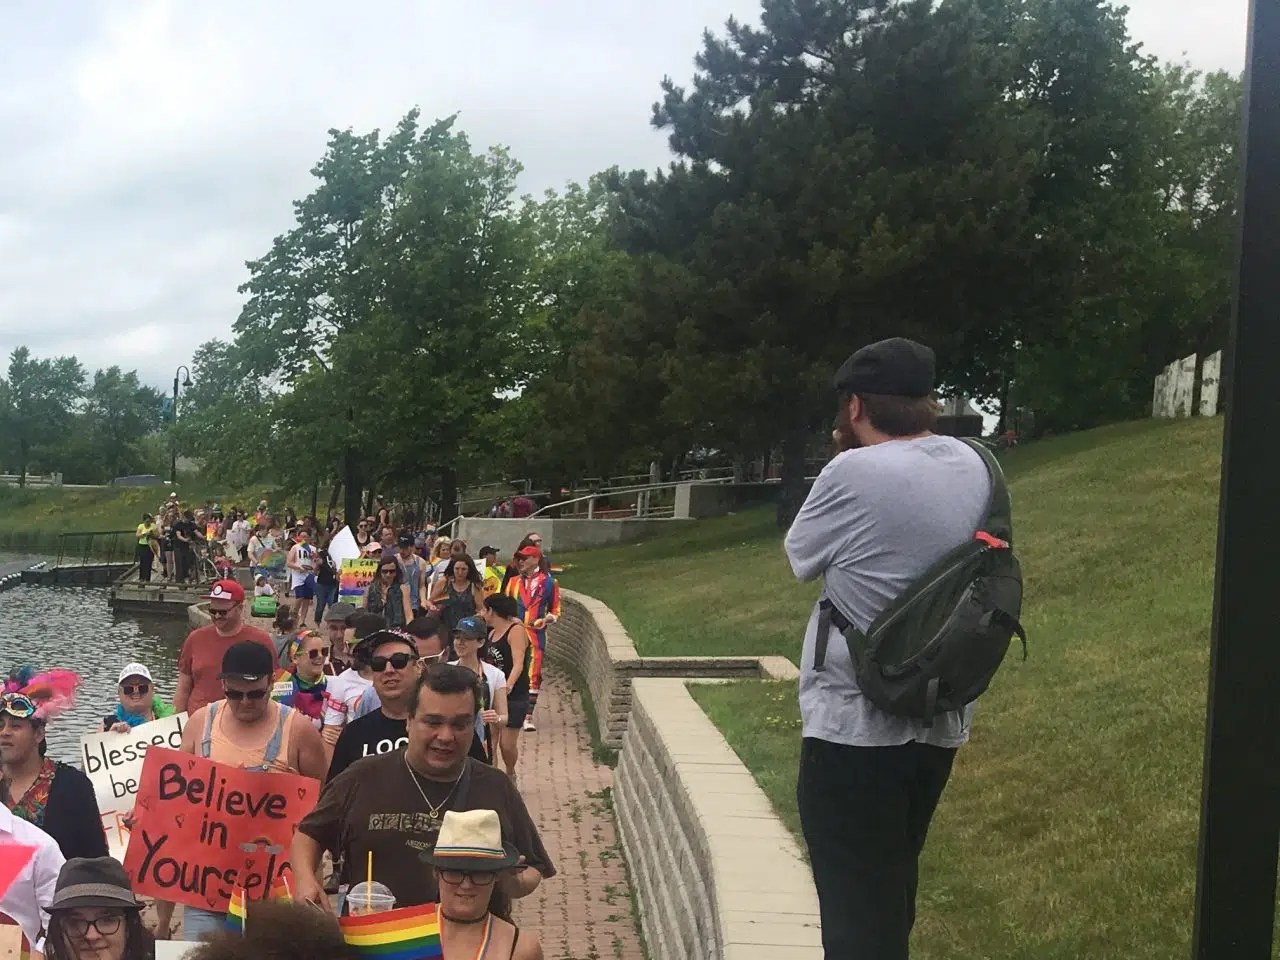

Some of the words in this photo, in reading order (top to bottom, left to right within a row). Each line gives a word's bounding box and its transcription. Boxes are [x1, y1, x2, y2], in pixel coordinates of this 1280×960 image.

[84, 716, 183, 774] blessed
[109, 773, 139, 799] be
[159, 762, 288, 820] Believe
[199, 813, 228, 850] in
